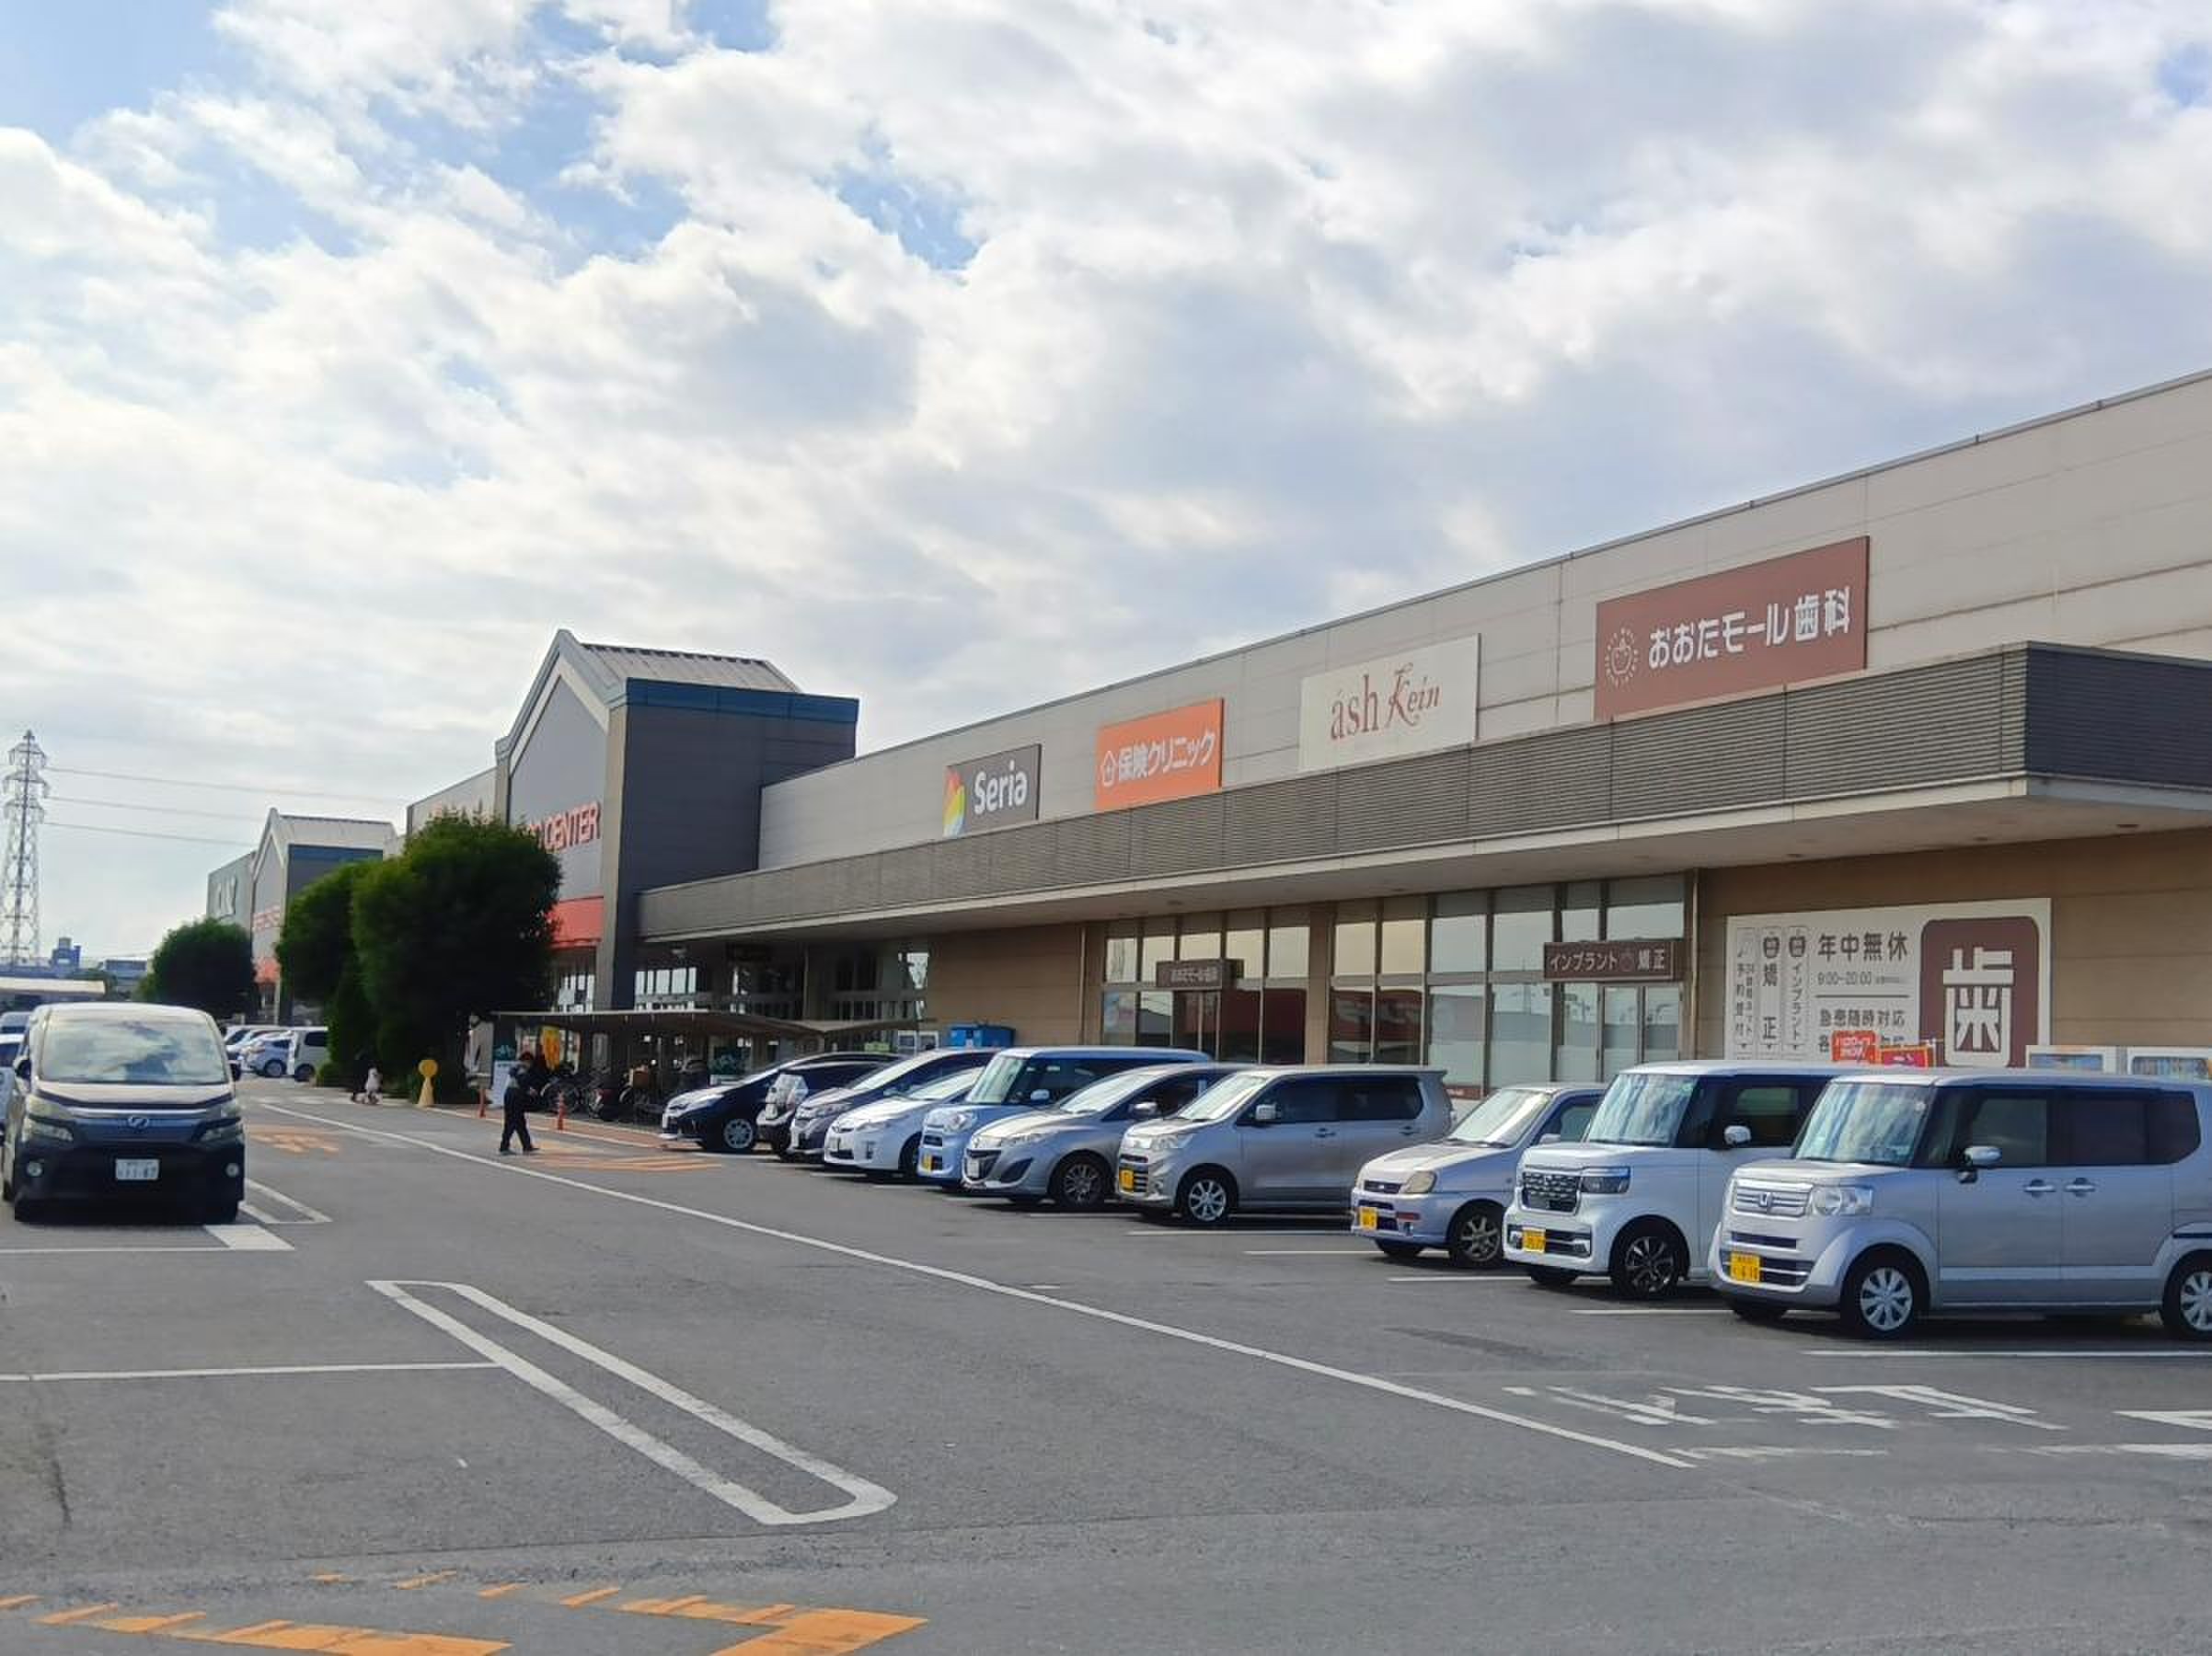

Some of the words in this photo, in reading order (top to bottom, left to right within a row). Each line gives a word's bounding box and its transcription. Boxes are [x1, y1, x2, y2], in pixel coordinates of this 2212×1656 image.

[1648, 586, 1850, 670] おおたモール歯科
[1331, 673, 1379, 741] ash
[1118, 730, 1216, 782] 保険クリニック
[973, 760, 1028, 815] Seria
[1550, 949, 1619, 972] インプラント
[1817, 931, 1908, 962] 年中無休
[1942, 947, 2014, 1067] 歯
